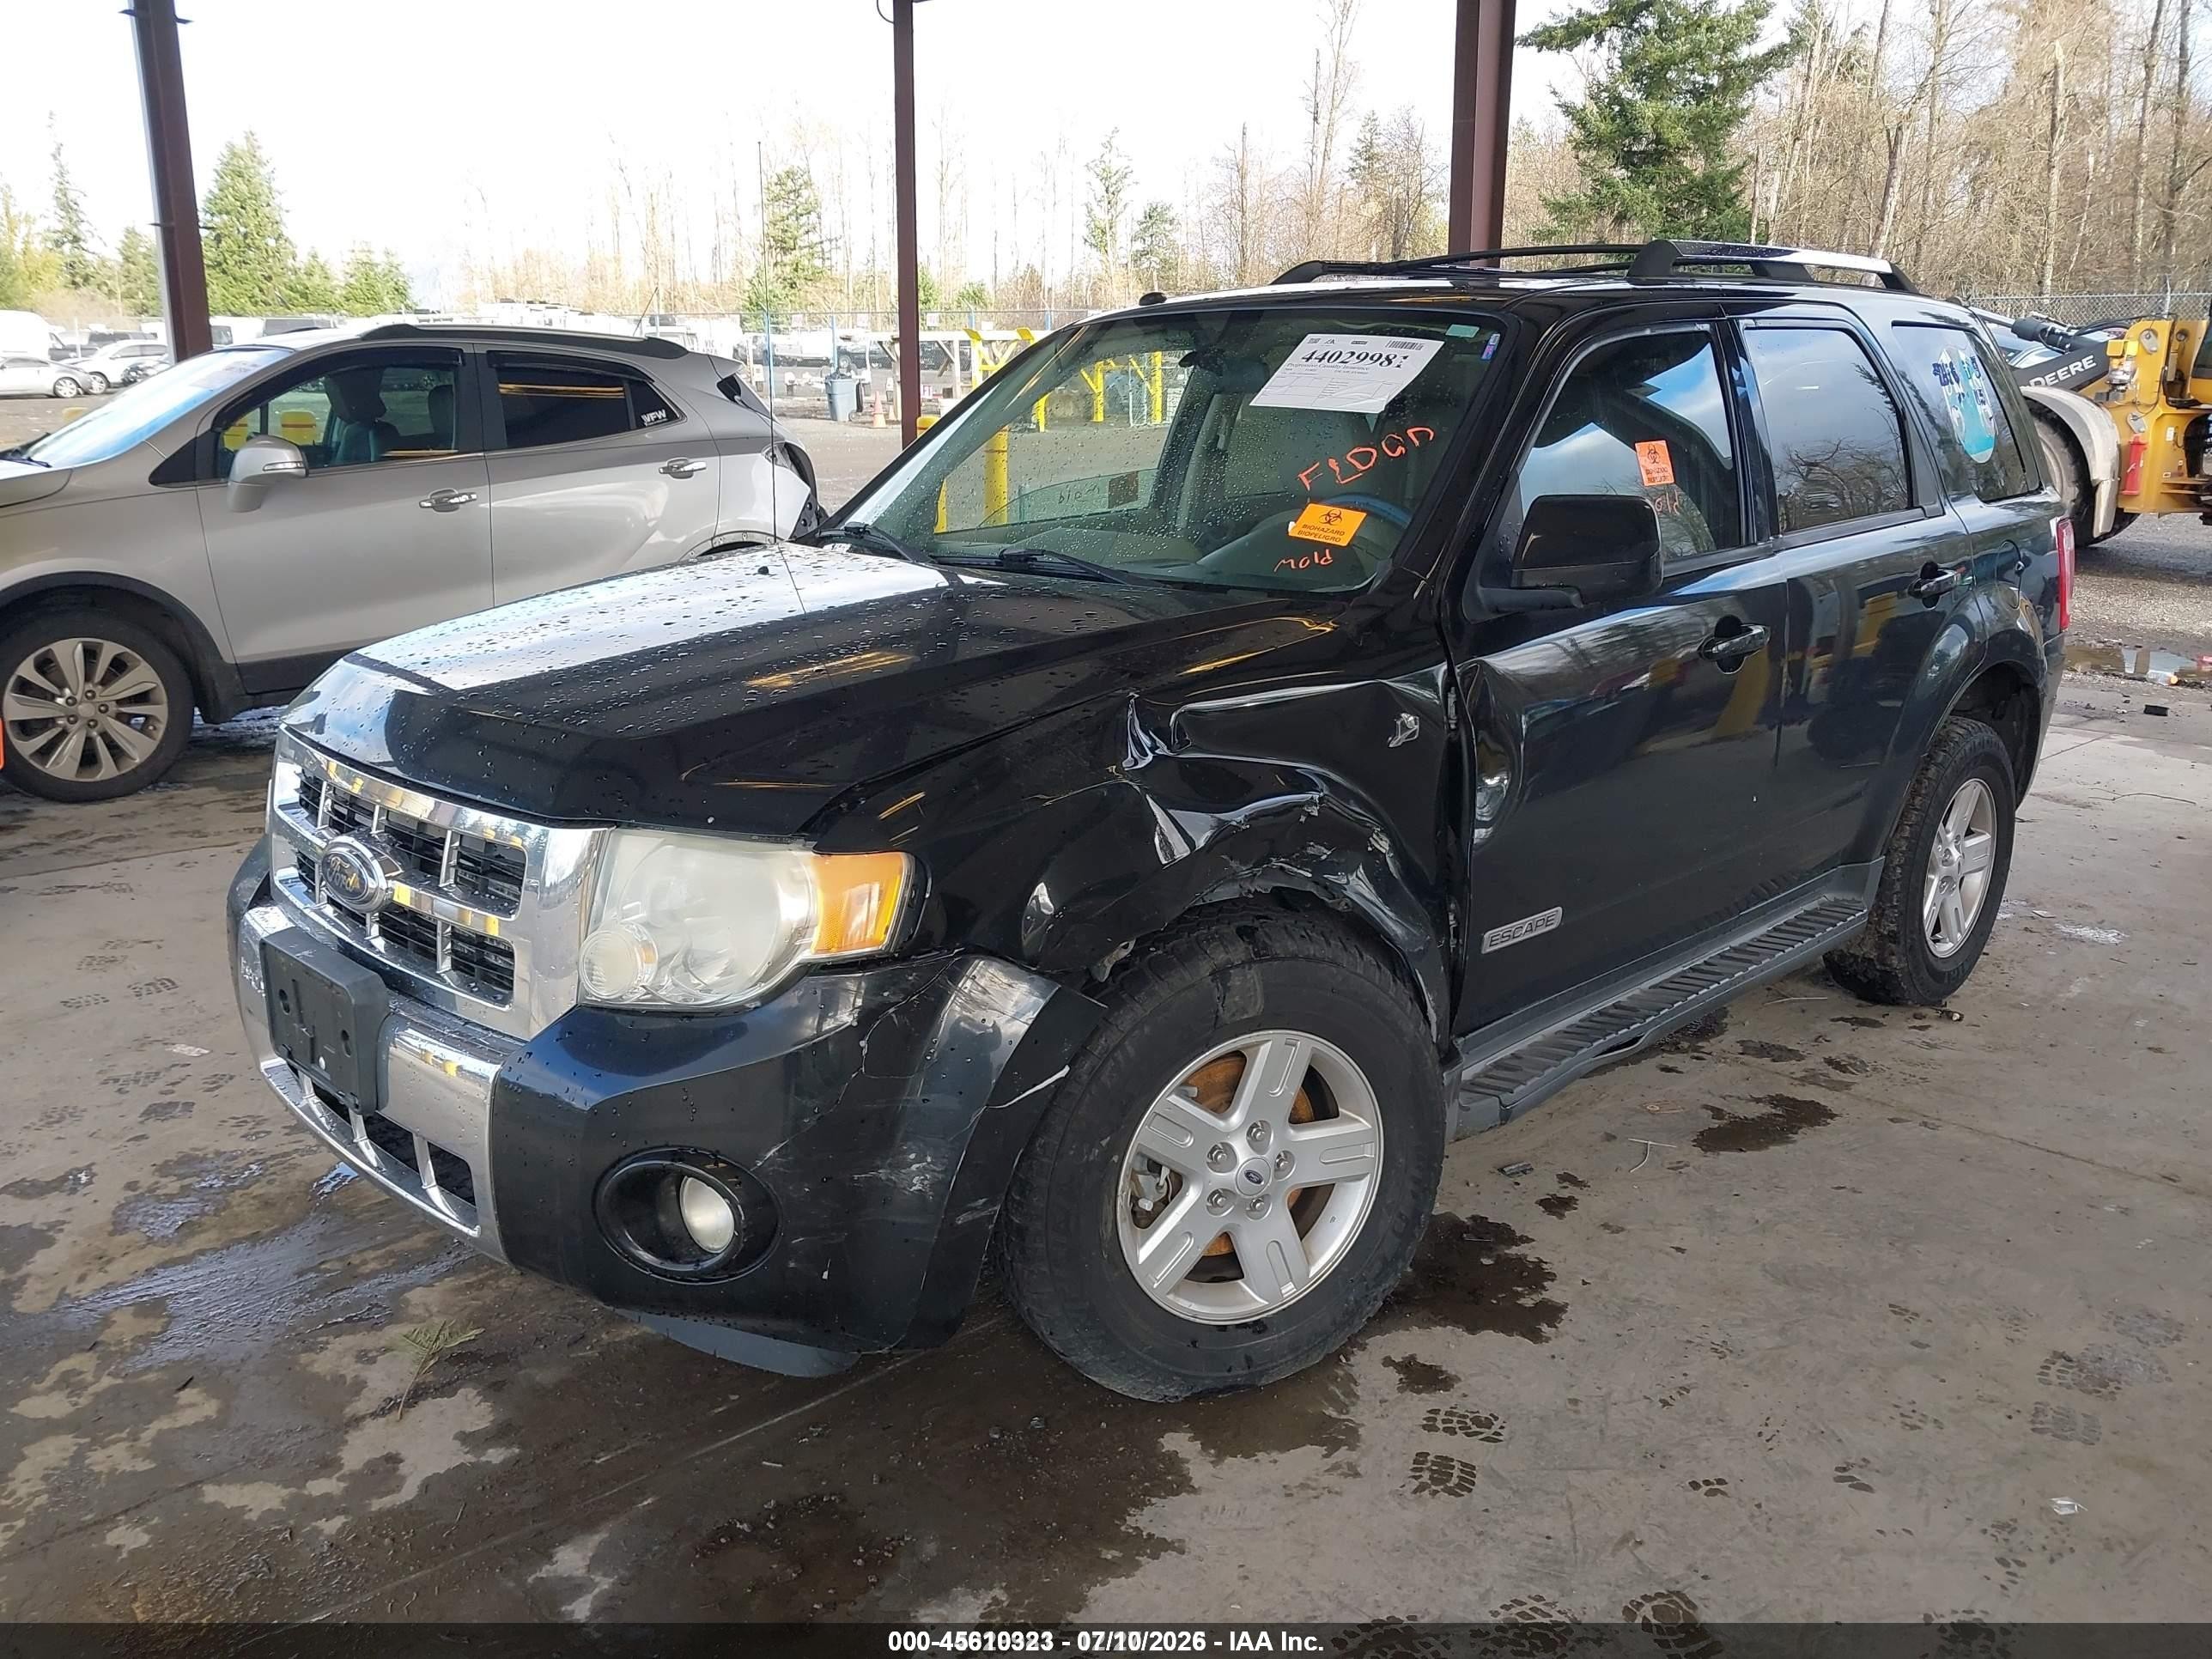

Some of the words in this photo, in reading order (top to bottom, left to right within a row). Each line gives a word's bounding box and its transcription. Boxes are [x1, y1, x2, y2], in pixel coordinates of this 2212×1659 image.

[2029, 355, 2097, 386] DEERE
[1655, 490, 1680, 515] old
[1297, 530, 1341, 543] BIOPELIGRO
[1302, 524, 1346, 537] BIOHAZARD
[327, 856, 357, 891] Ford
[1489, 912, 1556, 947] ESCAPE
